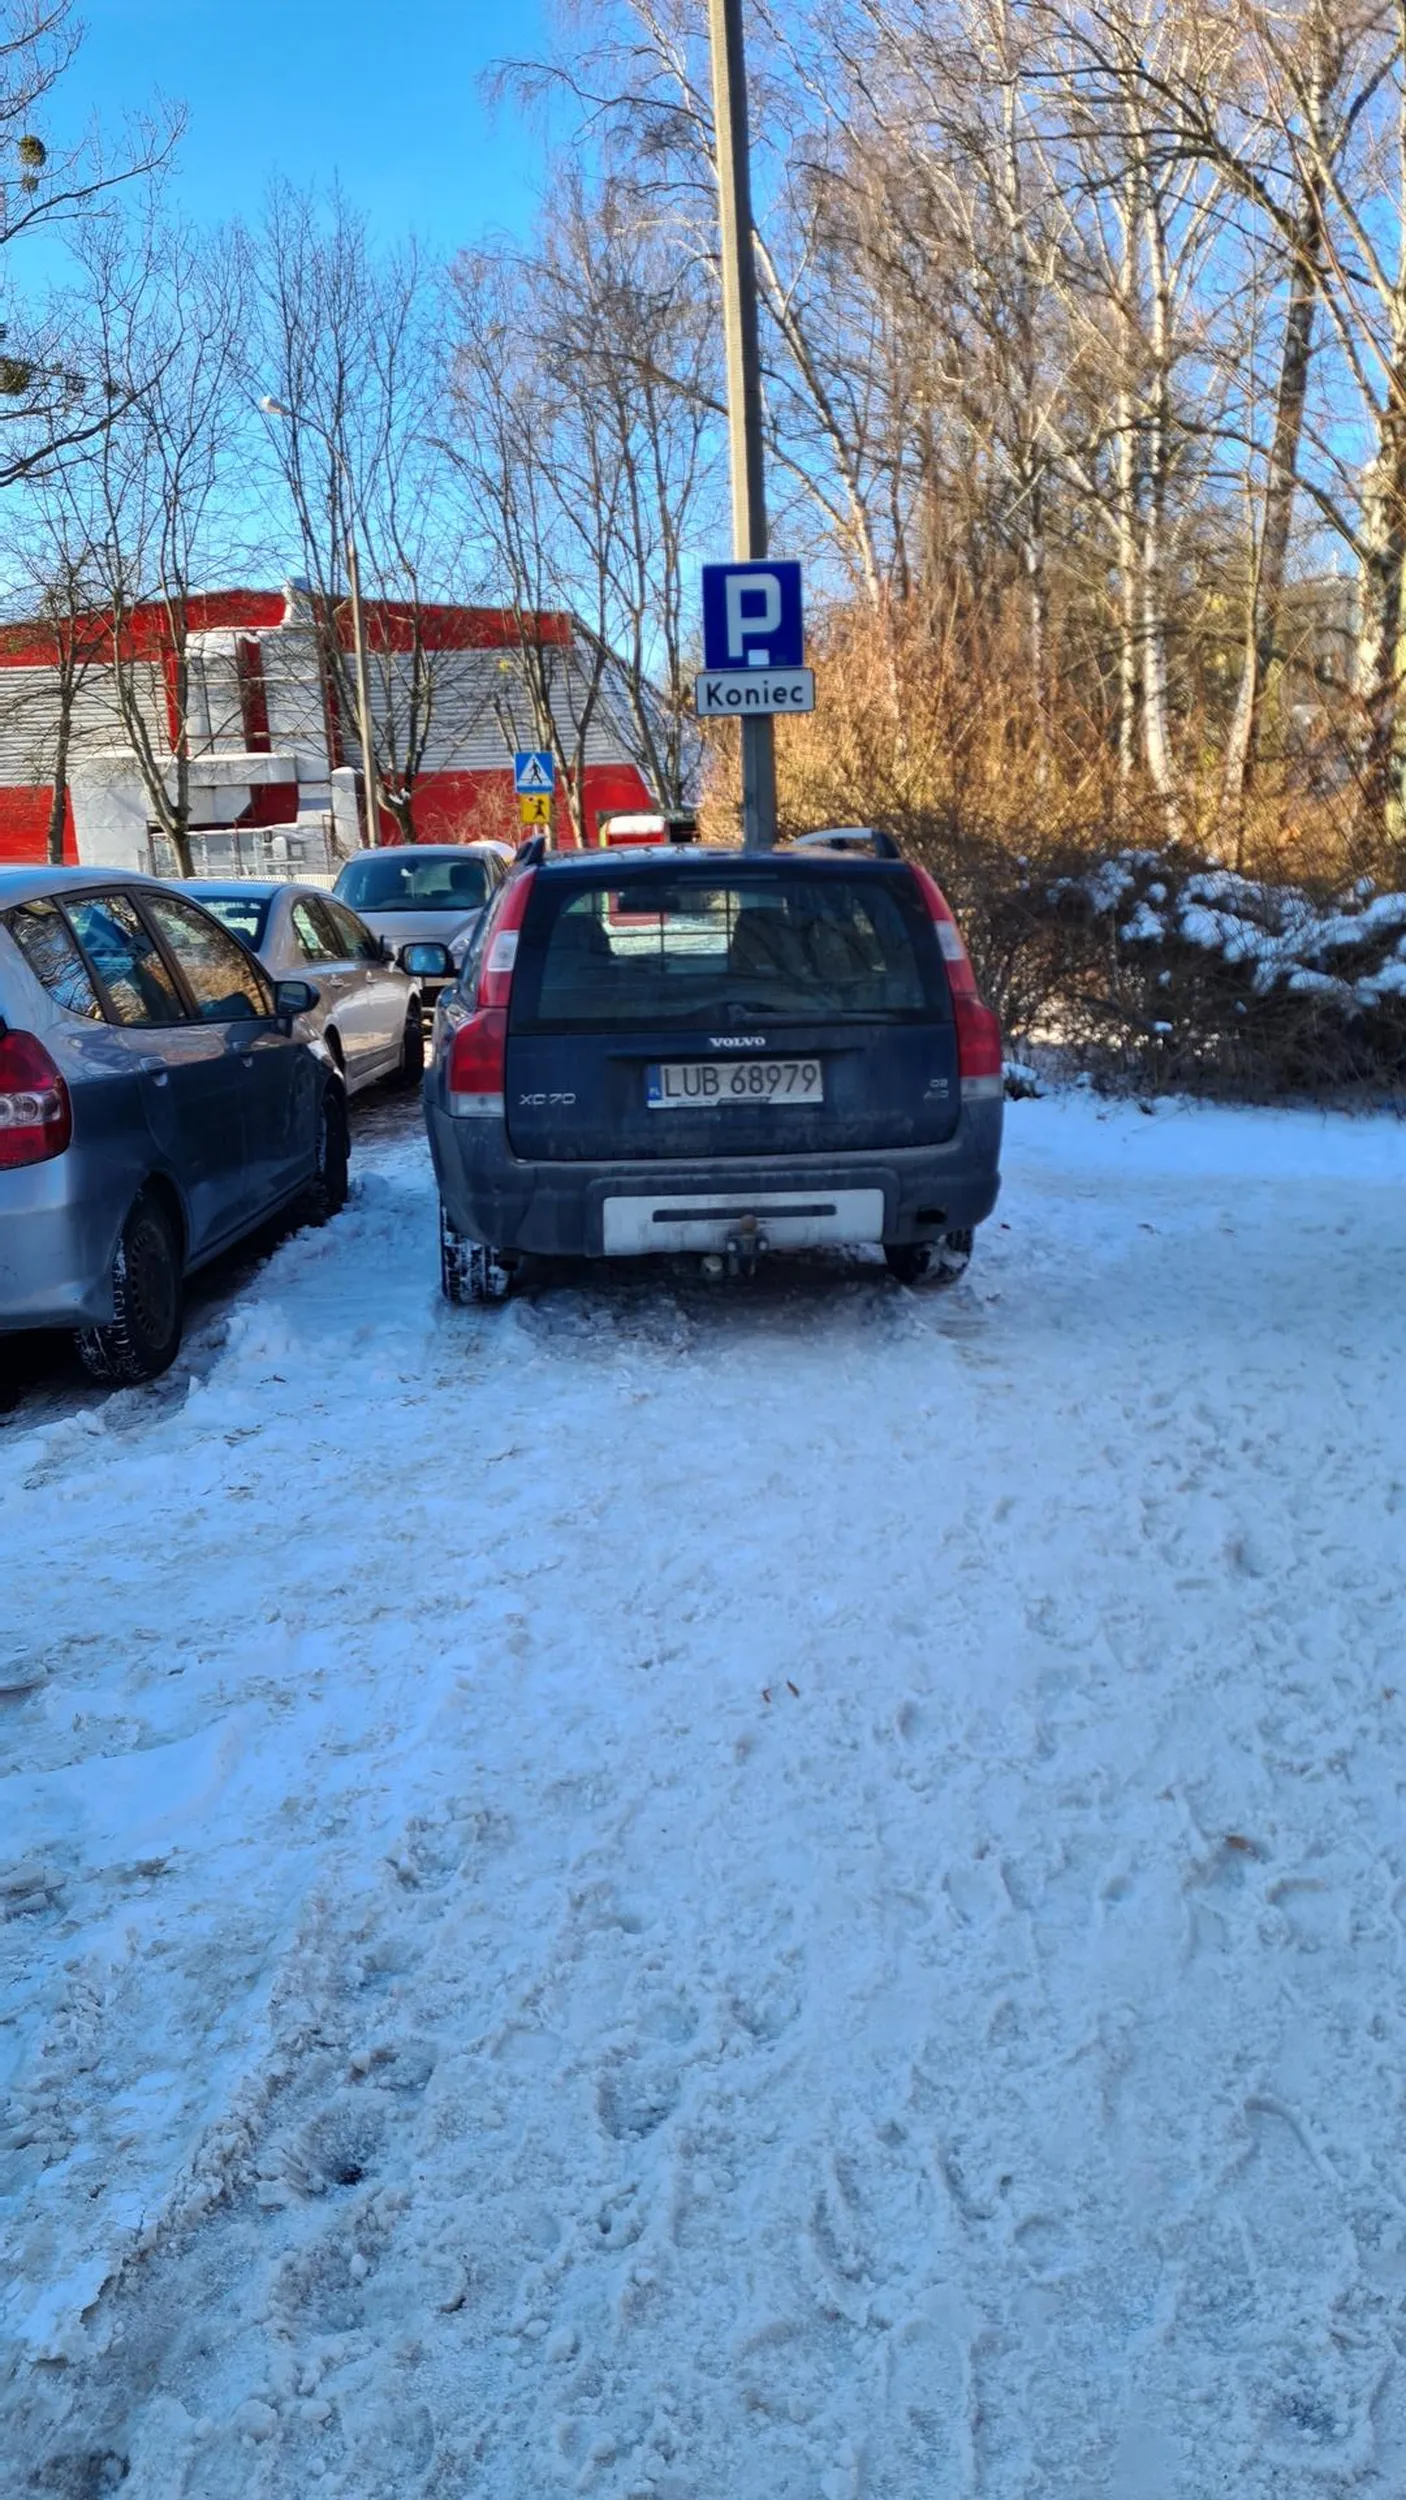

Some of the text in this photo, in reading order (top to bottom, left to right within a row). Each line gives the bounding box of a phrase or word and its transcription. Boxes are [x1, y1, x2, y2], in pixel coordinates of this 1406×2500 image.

[725, 573, 781, 658] P
[706, 681, 803, 707] Koniec
[709, 1037, 766, 1048] VOLVO
[665, 1064, 817, 1097] LUB 68979
